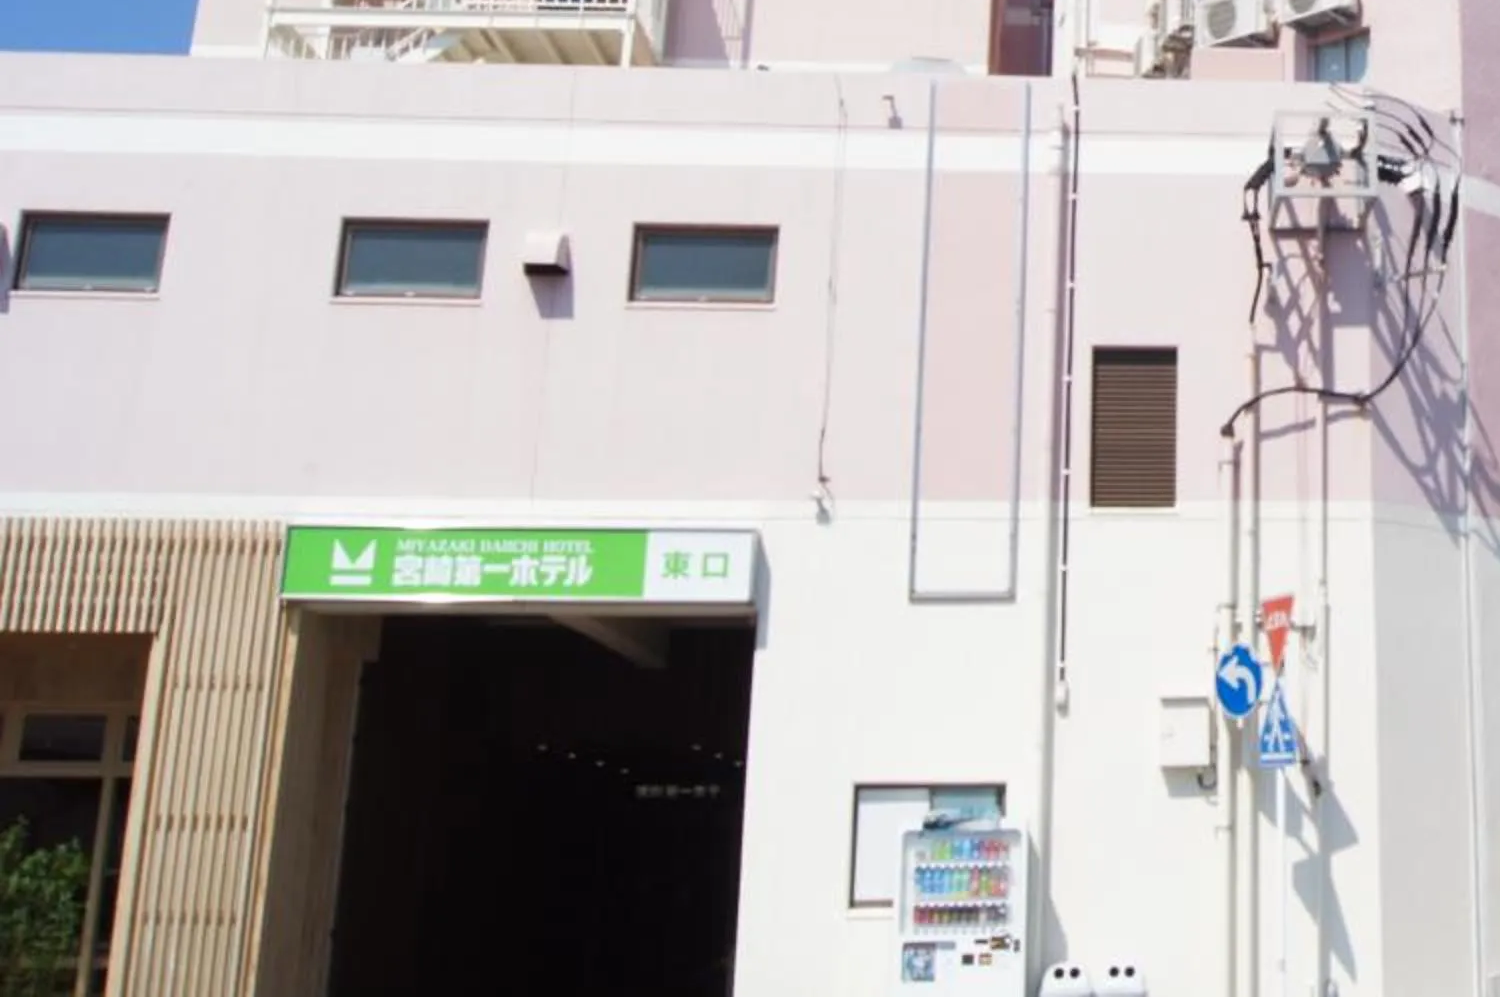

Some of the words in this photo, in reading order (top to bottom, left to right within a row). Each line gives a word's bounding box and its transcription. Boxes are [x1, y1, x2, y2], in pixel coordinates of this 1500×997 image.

[396, 539, 475, 553] MIYAZAKI
[480, 539, 539, 553] DAIICHI
[543, 540, 595, 554] HOTEL
[391, 554, 594, 588] 宮崎第一ホテル
[661, 550, 729, 579] 東口
